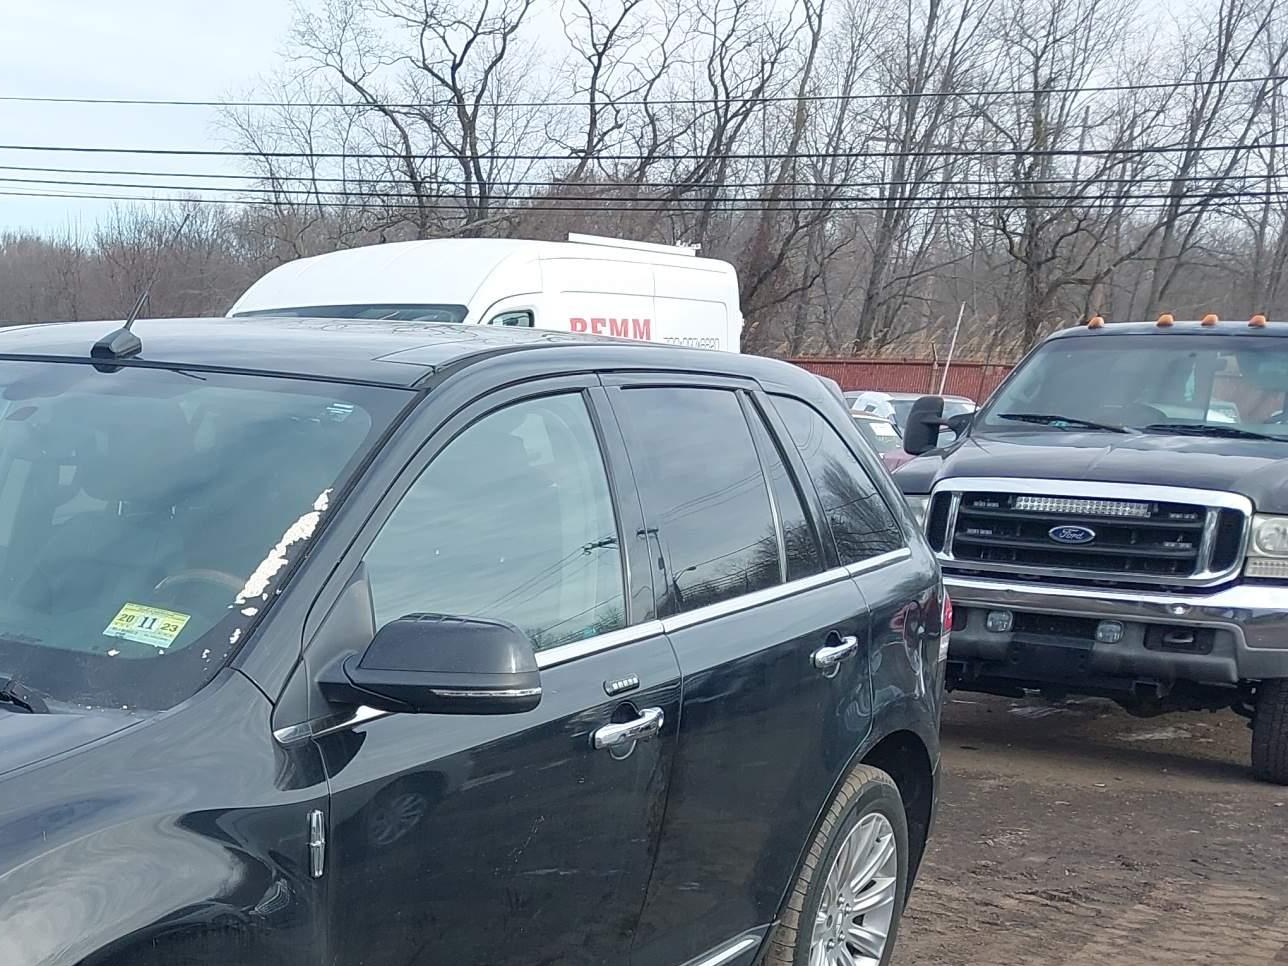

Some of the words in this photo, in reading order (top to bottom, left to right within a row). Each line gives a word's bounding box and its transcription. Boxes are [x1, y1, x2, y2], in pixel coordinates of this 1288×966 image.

[117, 613, 136, 624] 20
[137, 615, 158, 630] 11
[159, 622, 179, 633] 23
